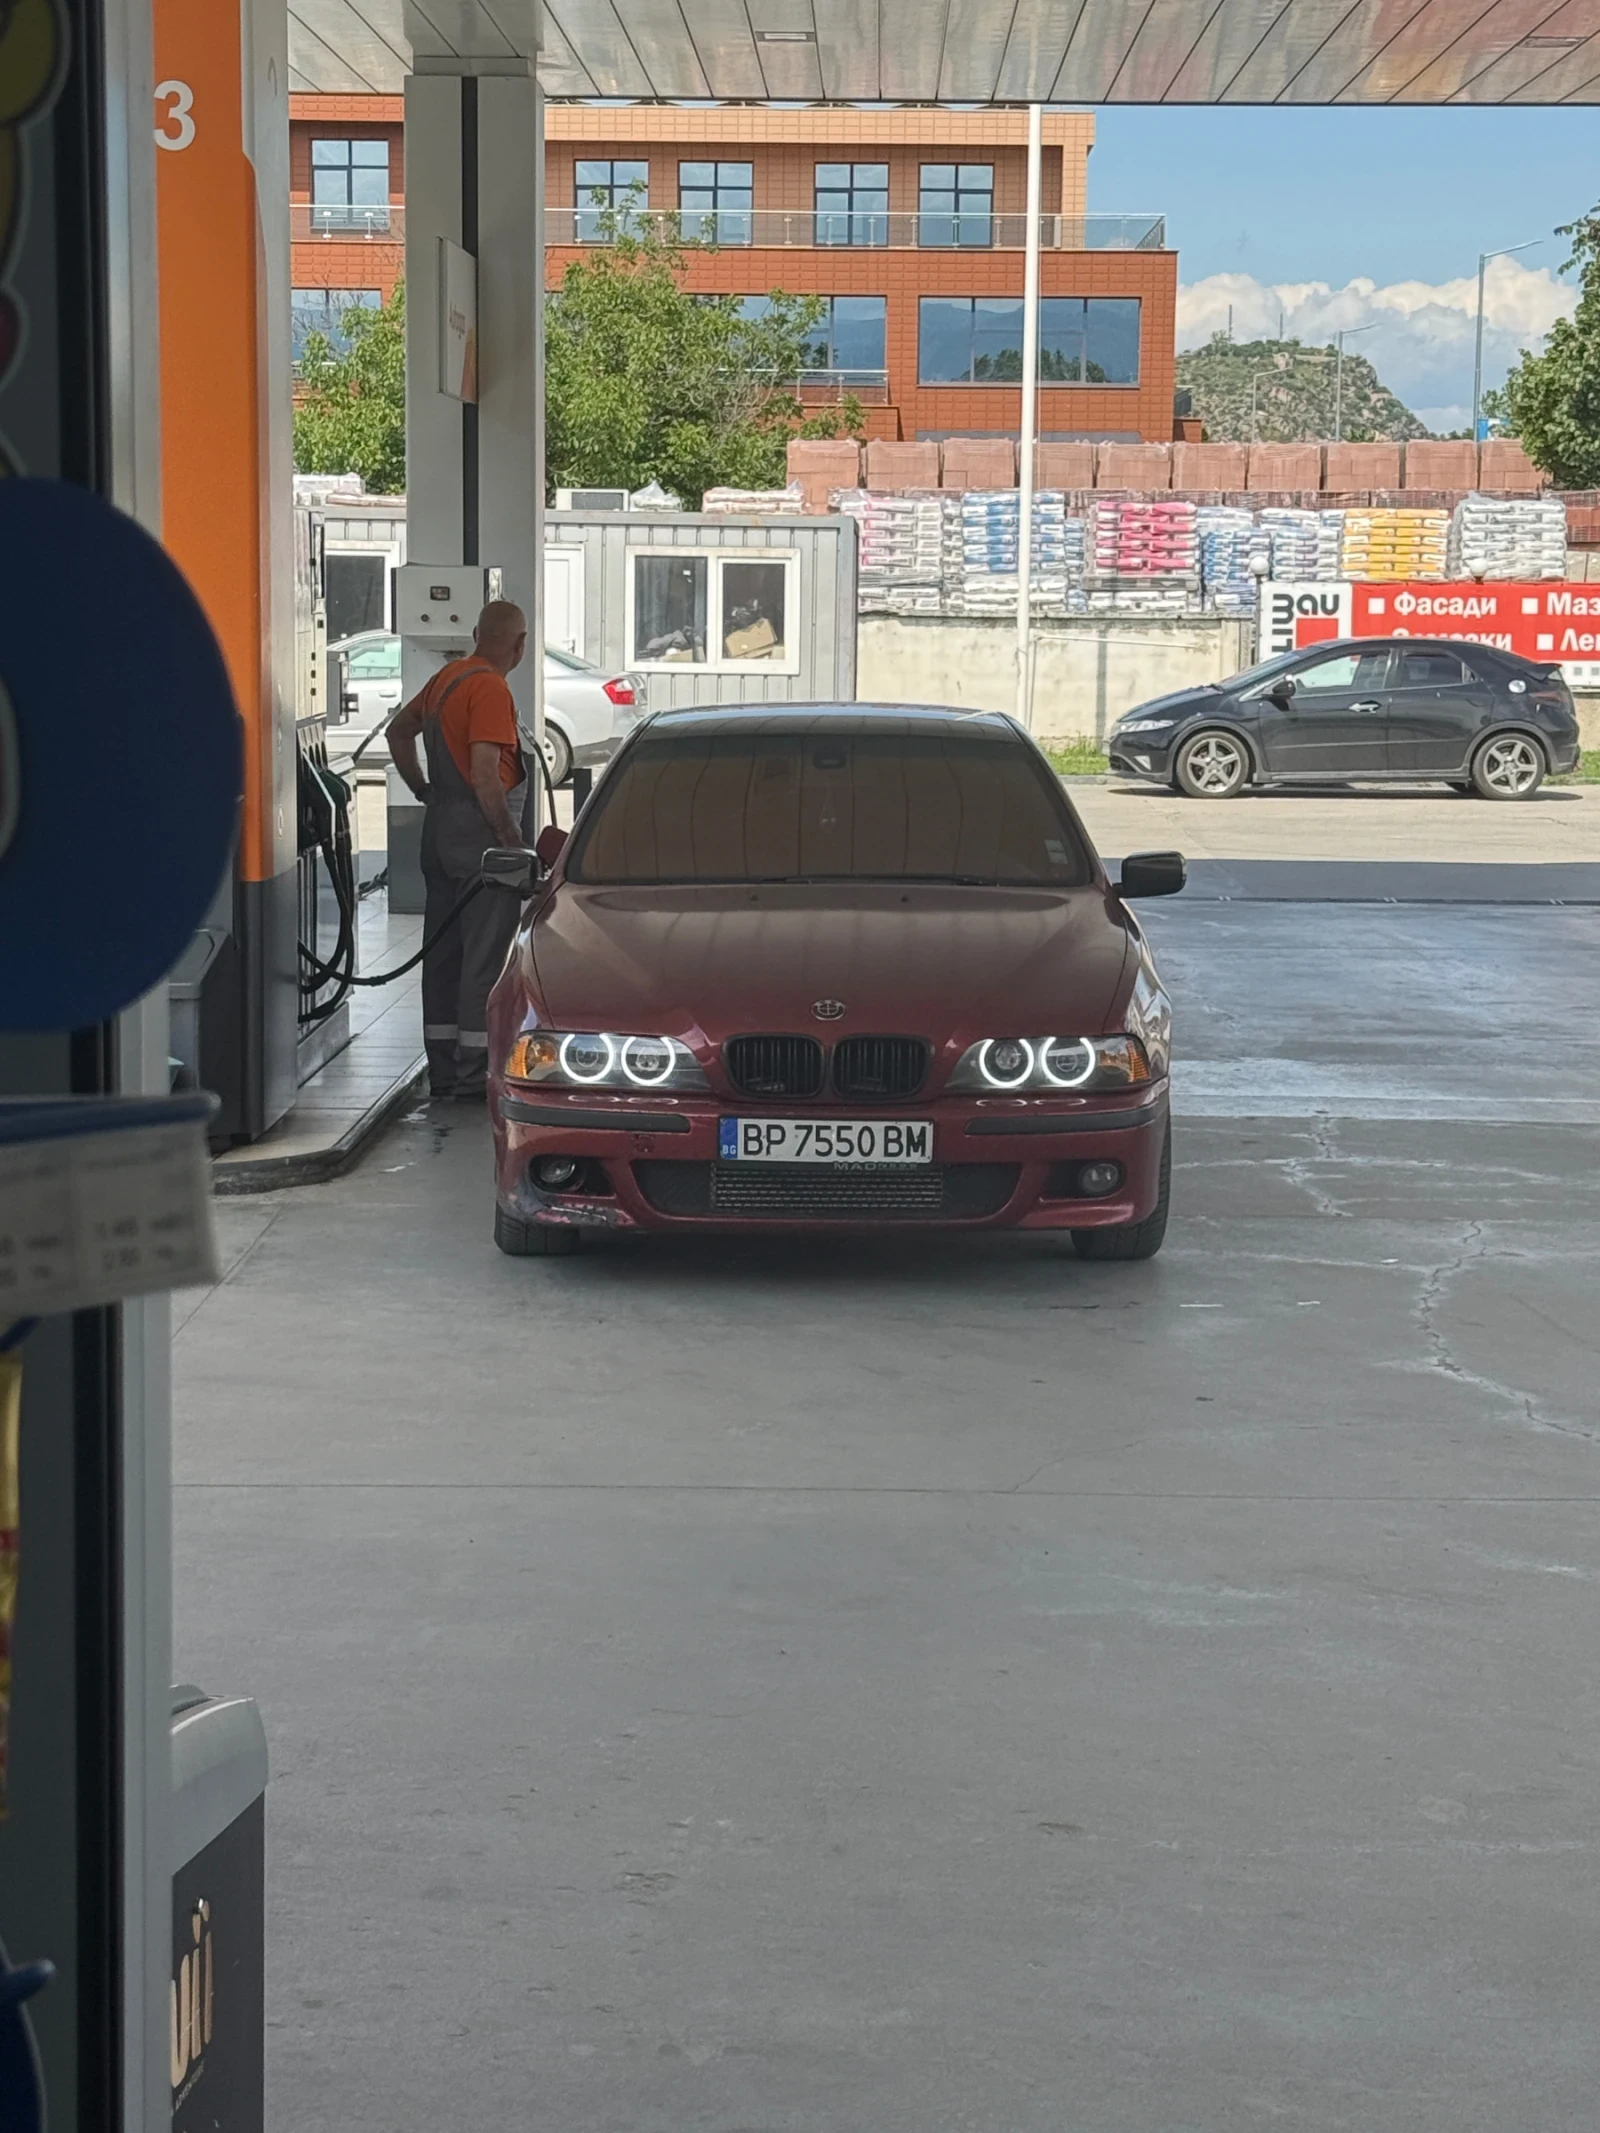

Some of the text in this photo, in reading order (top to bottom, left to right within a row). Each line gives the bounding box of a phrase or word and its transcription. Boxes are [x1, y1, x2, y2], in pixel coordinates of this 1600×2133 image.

[153, 79, 196, 151] 3
[1393, 591, 1497, 619] Фасади
[1547, 592, 1600, 616] Маз
[722, 1144, 737, 1155] BG
[743, 1123, 927, 1158] BP 7550 BM
